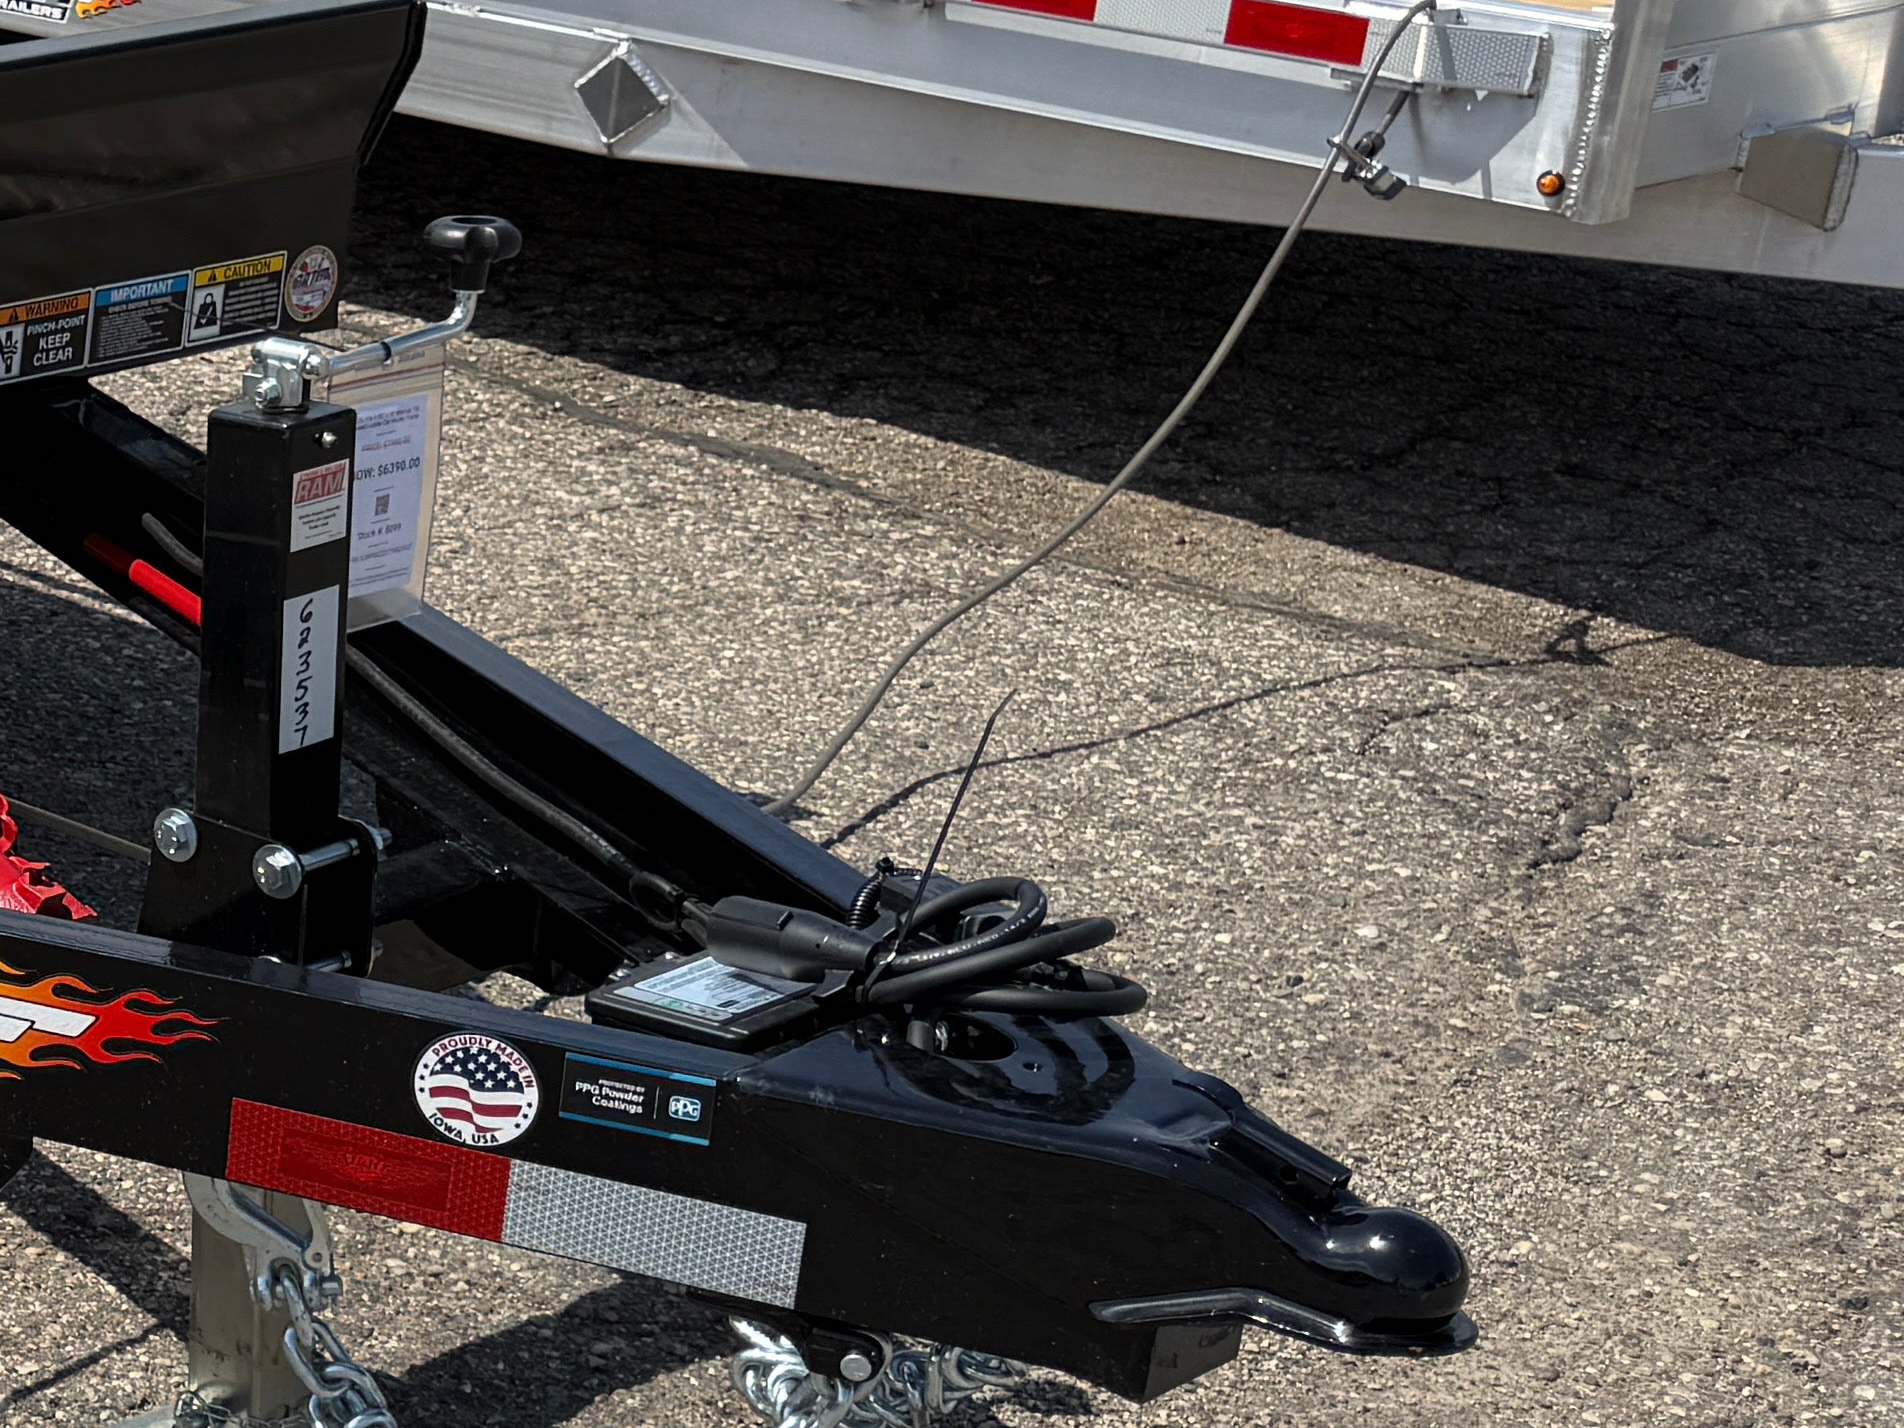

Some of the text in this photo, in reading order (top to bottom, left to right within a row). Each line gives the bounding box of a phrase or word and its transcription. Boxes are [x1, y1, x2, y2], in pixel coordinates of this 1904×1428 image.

[223, 258, 272, 280] CAUTION
[110, 278, 174, 302] IMPORTANT
[24, 297, 80, 319] WARNING
[26, 315, 86, 336] PINCH-POINT
[39, 332, 71, 351] KEEP
[33, 347, 73, 367] CLEAR
[354, 466, 376, 481] OW:
[295, 467, 345, 504] RAM
[432, 1036, 535, 1089] PROUDLY MADE IN
[575, 1081, 644, 1103] PPG Powder
[592, 1095, 643, 1114] Coatings
[671, 1099, 698, 1117] PPG
[429, 1113, 500, 1145] IOWA, USA
